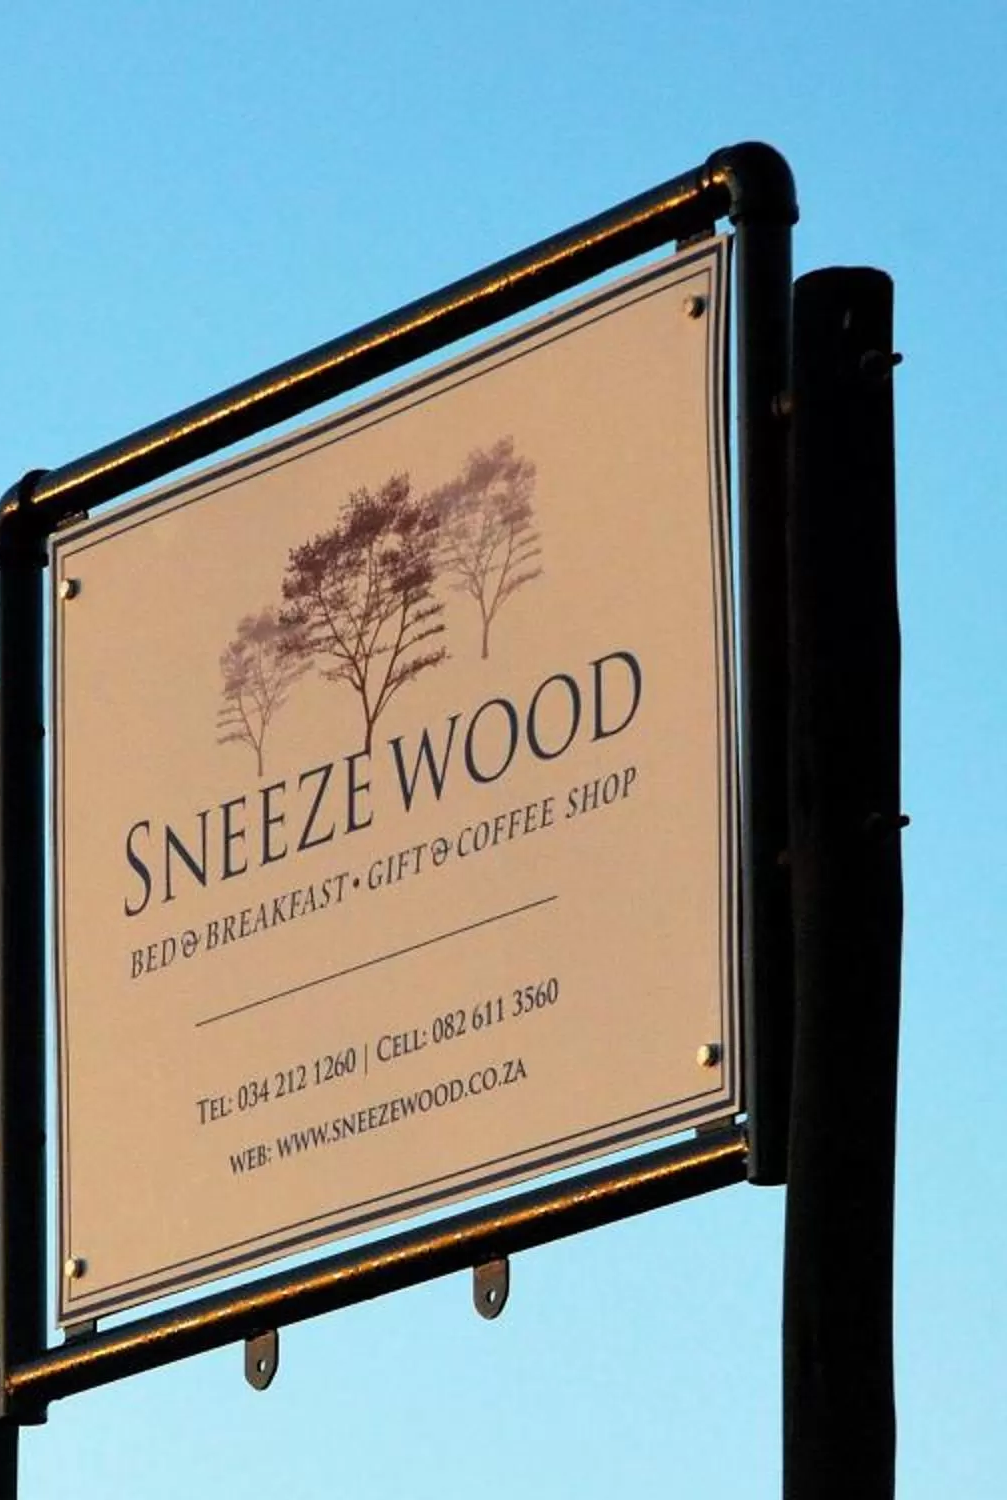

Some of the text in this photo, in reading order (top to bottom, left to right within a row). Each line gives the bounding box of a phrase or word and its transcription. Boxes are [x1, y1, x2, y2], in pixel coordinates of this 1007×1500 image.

[124, 651, 642, 918] SNEEZEWOOD
[565, 766, 637, 819] SHOP
[237, 1078, 270, 1112] 034
[275, 1065, 307, 1099] 212
[314, 1047, 357, 1085] 1260
[432, 1009, 466, 1044] 082
[472, 996, 504, 1030] 611
[512, 977, 559, 1017] 3560
[229, 1057, 528, 1175] WEB: WWW.SNEEZEWOOD.CO.ZA
